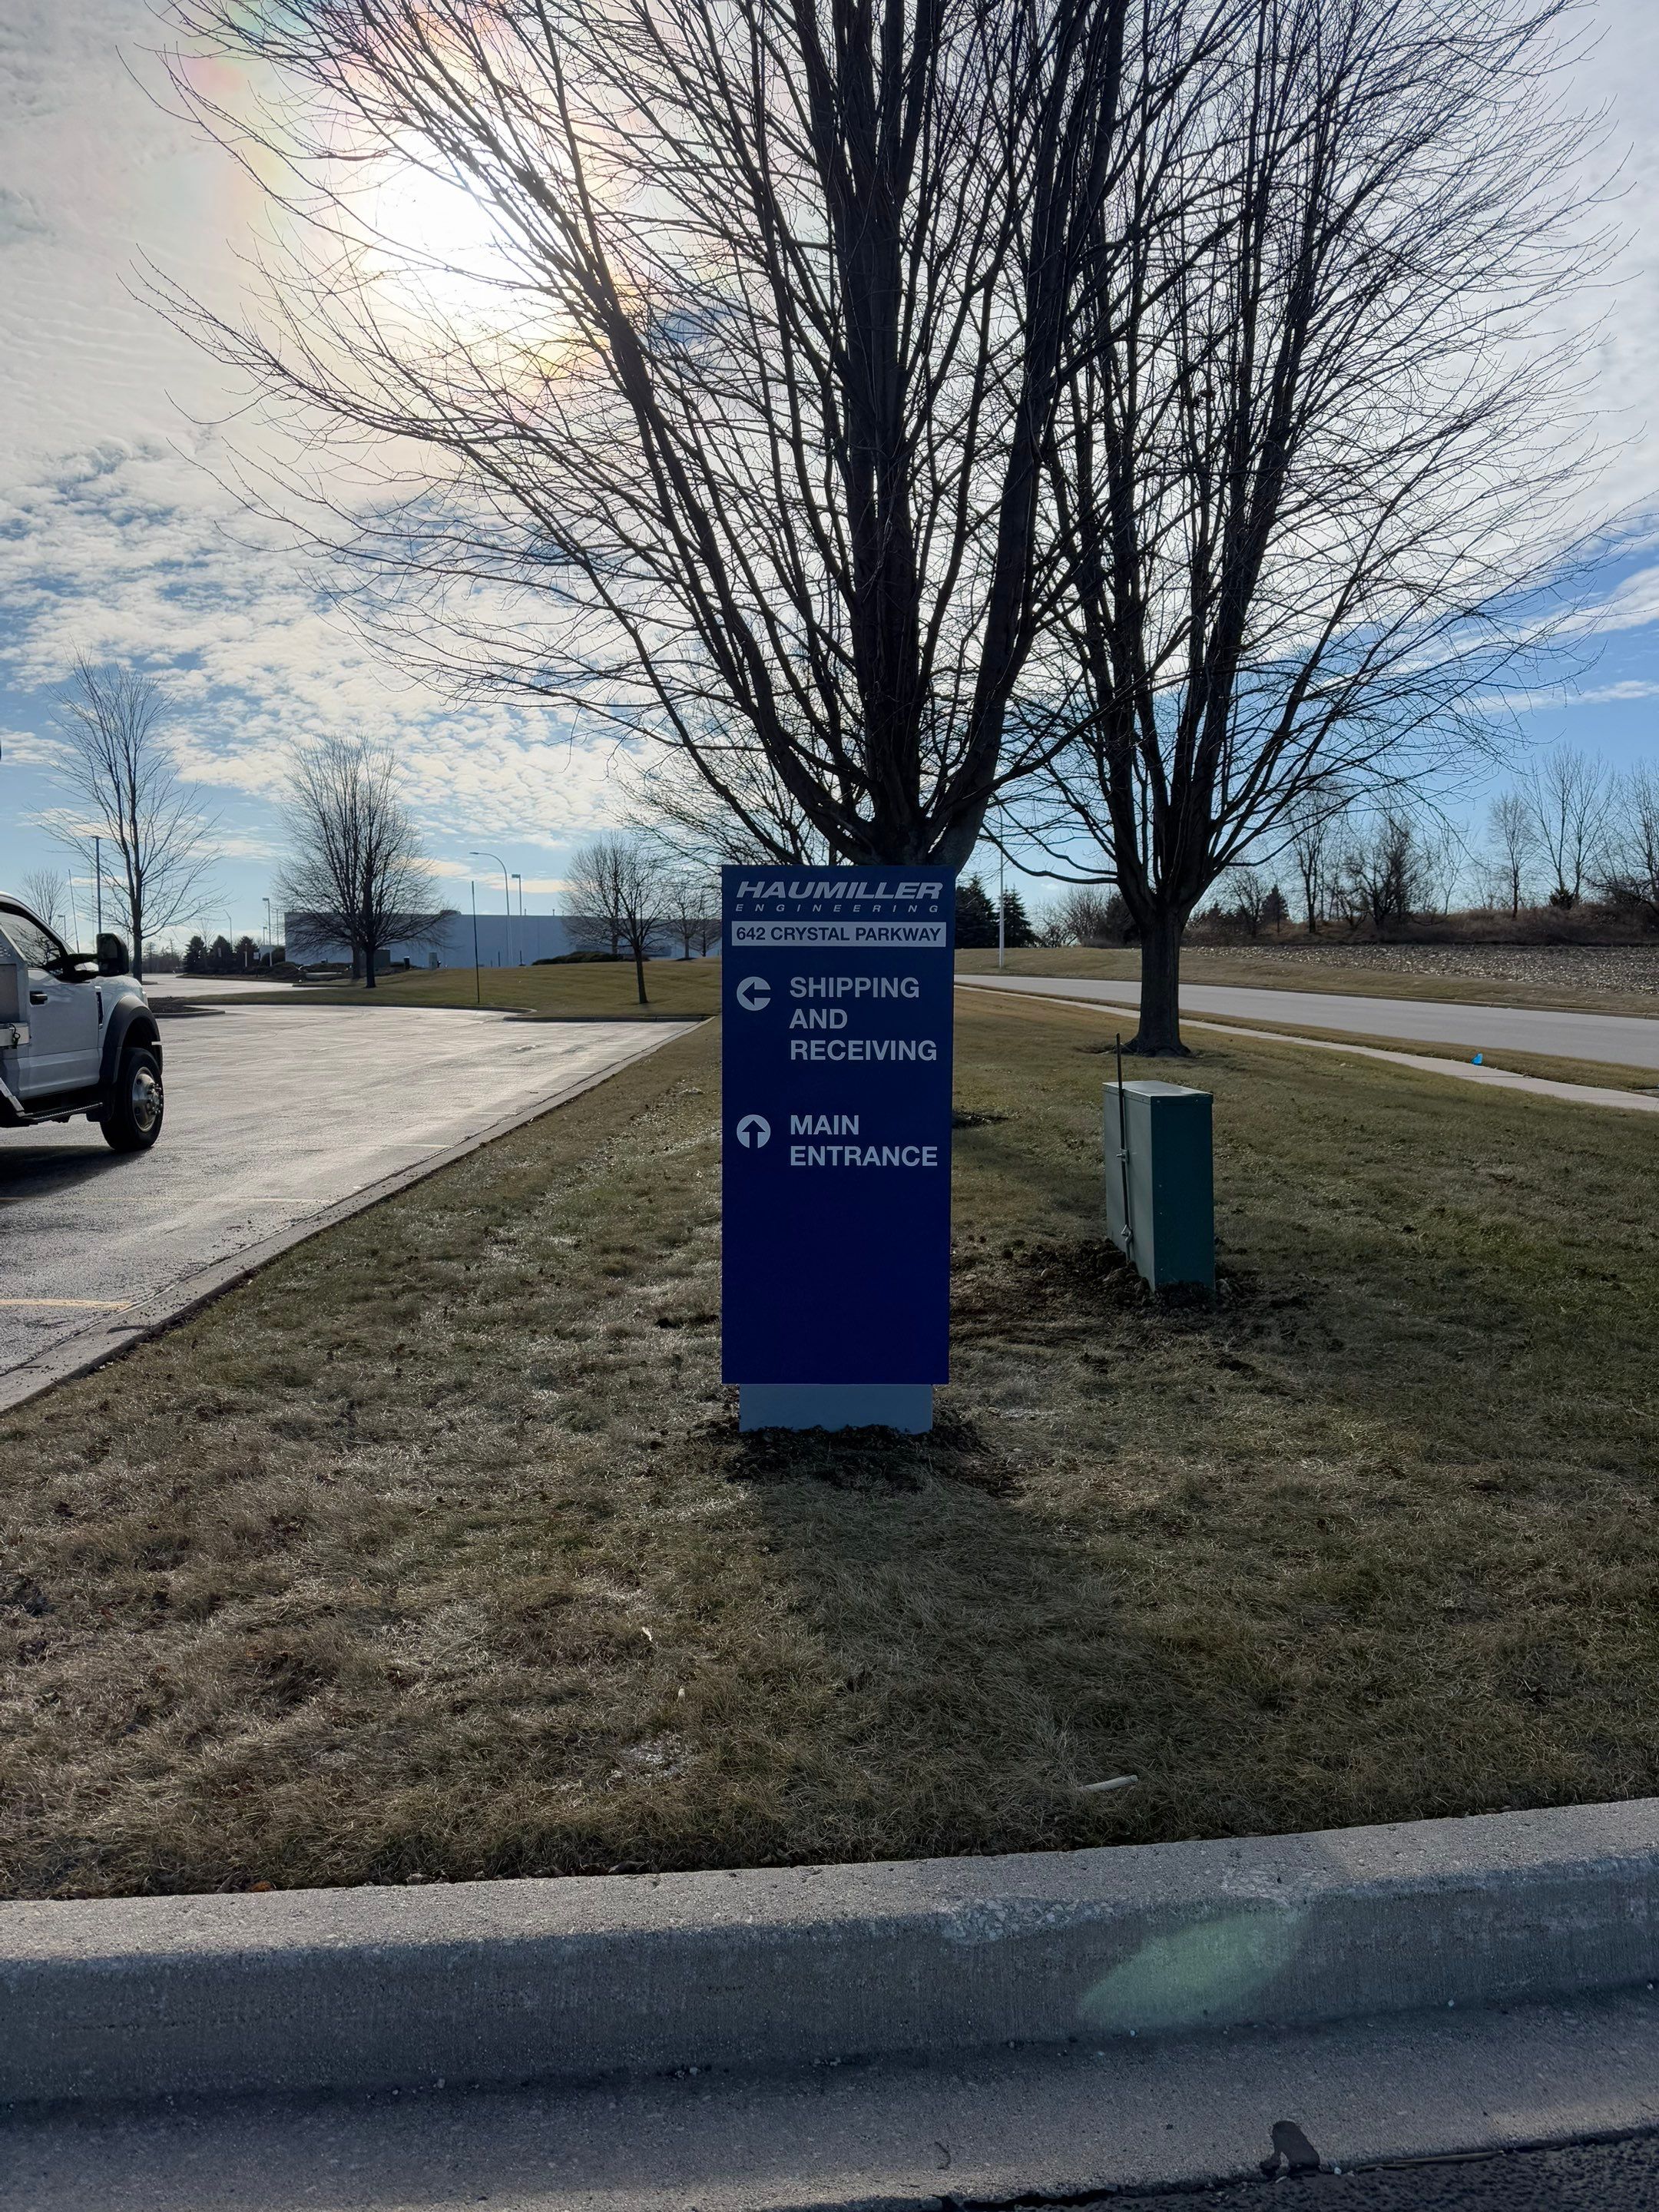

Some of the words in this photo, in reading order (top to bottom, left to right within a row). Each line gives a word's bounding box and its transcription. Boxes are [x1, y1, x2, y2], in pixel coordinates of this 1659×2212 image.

[736, 881, 944, 900] HAUMILLER
[735, 903, 939, 913] ENGINEERING
[736, 926, 766, 941] 642
[770, 926, 850, 942] CRYSTAL
[855, 927, 942, 942] PARKWAY
[790, 976, 920, 998] SHIPPING
[789, 1008, 848, 1029] AND
[790, 1039, 938, 1061] RECEIVING
[790, 1114, 859, 1135] MAIN
[790, 1145, 938, 1167] ENTRANCE
